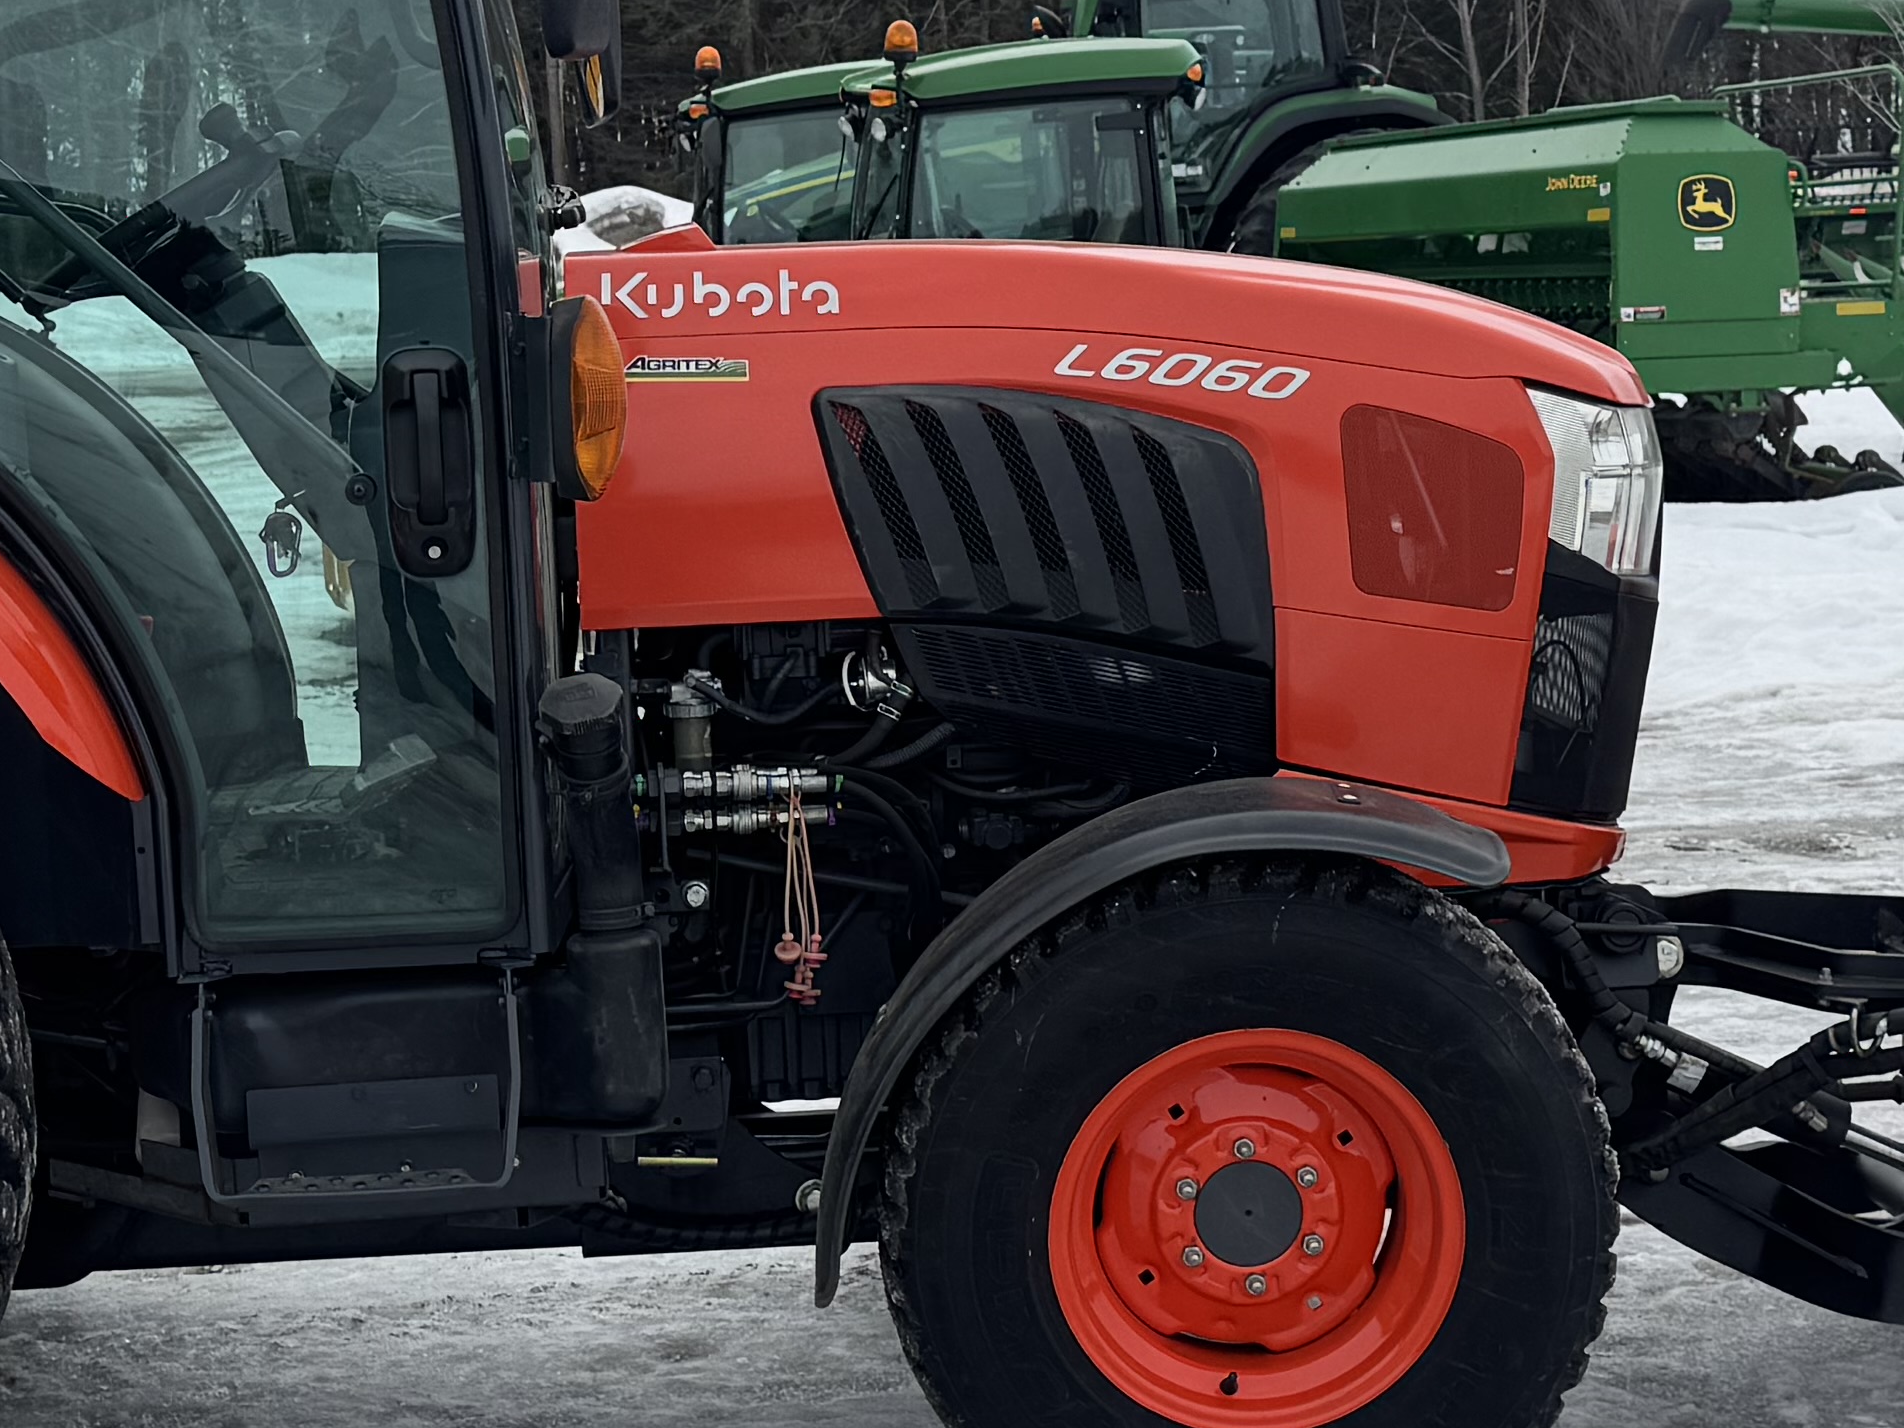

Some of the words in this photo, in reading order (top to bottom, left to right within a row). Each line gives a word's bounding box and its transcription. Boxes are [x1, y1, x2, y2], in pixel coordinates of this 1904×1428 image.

[1546, 176, 1569, 191] JOHN
[1570, 174, 1598, 189] DEERE
[600, 269, 840, 319] Kubota
[625, 357, 722, 371] AGRITEX
[1053, 344, 1311, 399] L6060
